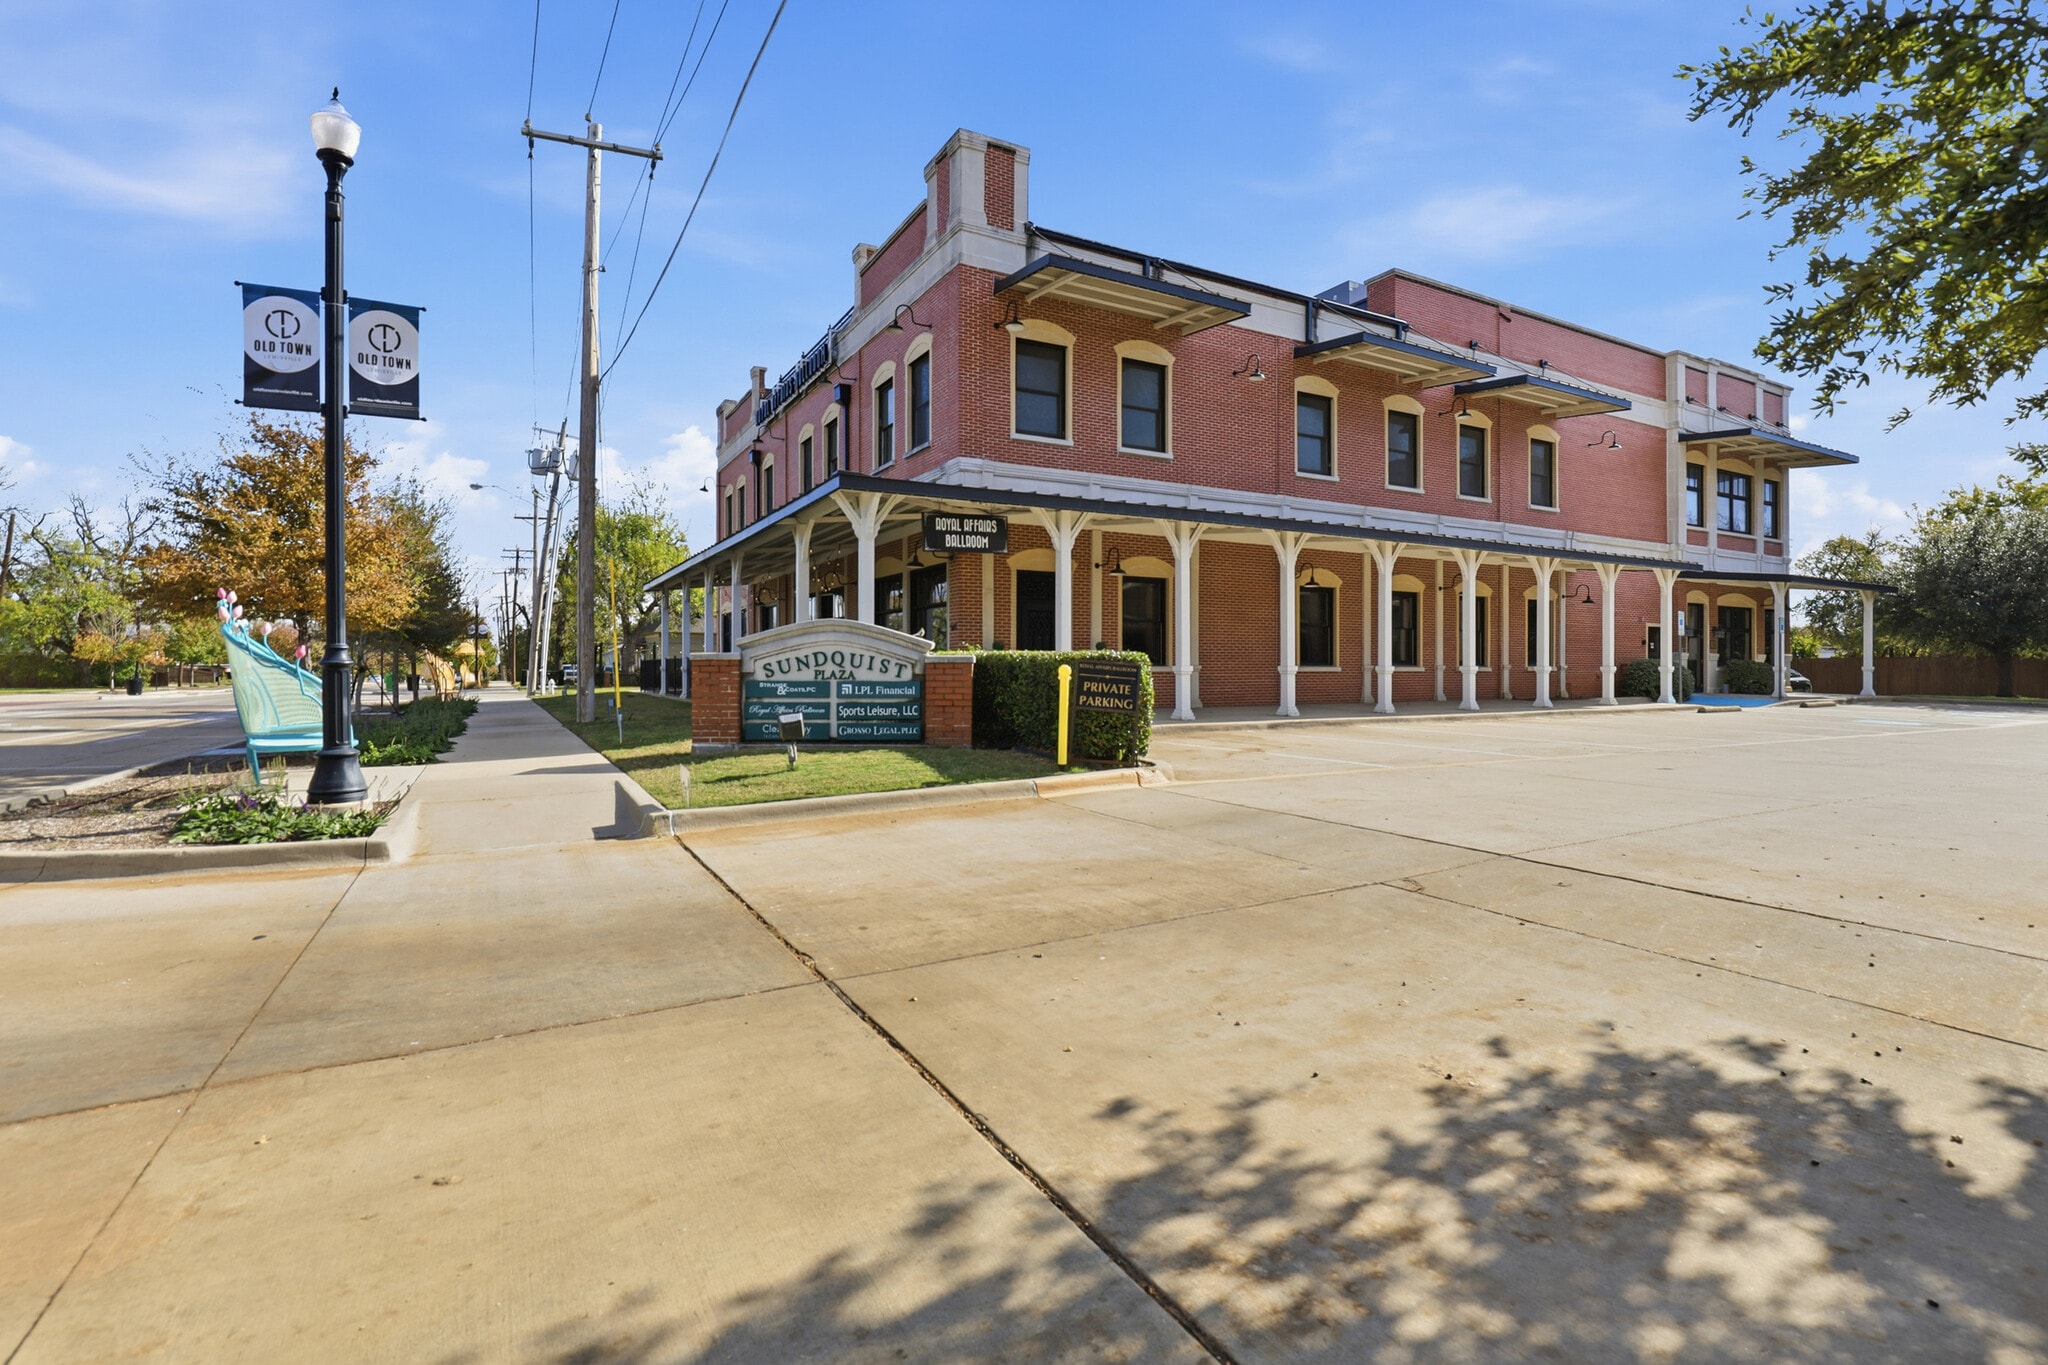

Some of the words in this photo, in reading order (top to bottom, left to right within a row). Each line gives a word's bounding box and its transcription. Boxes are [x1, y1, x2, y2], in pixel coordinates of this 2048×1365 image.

[254, 339, 276, 353] OLD
[280, 341, 312, 356] TOWN
[357, 352, 378, 366] OLD
[382, 355, 412, 370] TOWN
[935, 517, 962, 532] ROYAL
[964, 518, 998, 534] AFFAIRS
[945, 534, 989, 549] BALLROOM
[763, 651, 908, 678] SUNDQUIST
[814, 669, 856, 680] PLAZA
[855, 686, 874, 695] LPL
[875, 686, 916, 695] Financial
[1083, 681, 1132, 695] PRIVATE
[1079, 695, 1134, 710] PARKING
[839, 706, 865, 717] Sports
[867, 705, 900, 717] Leisure,
[903, 705, 918, 716] LLC
[839, 726, 872, 735] GROSSO
